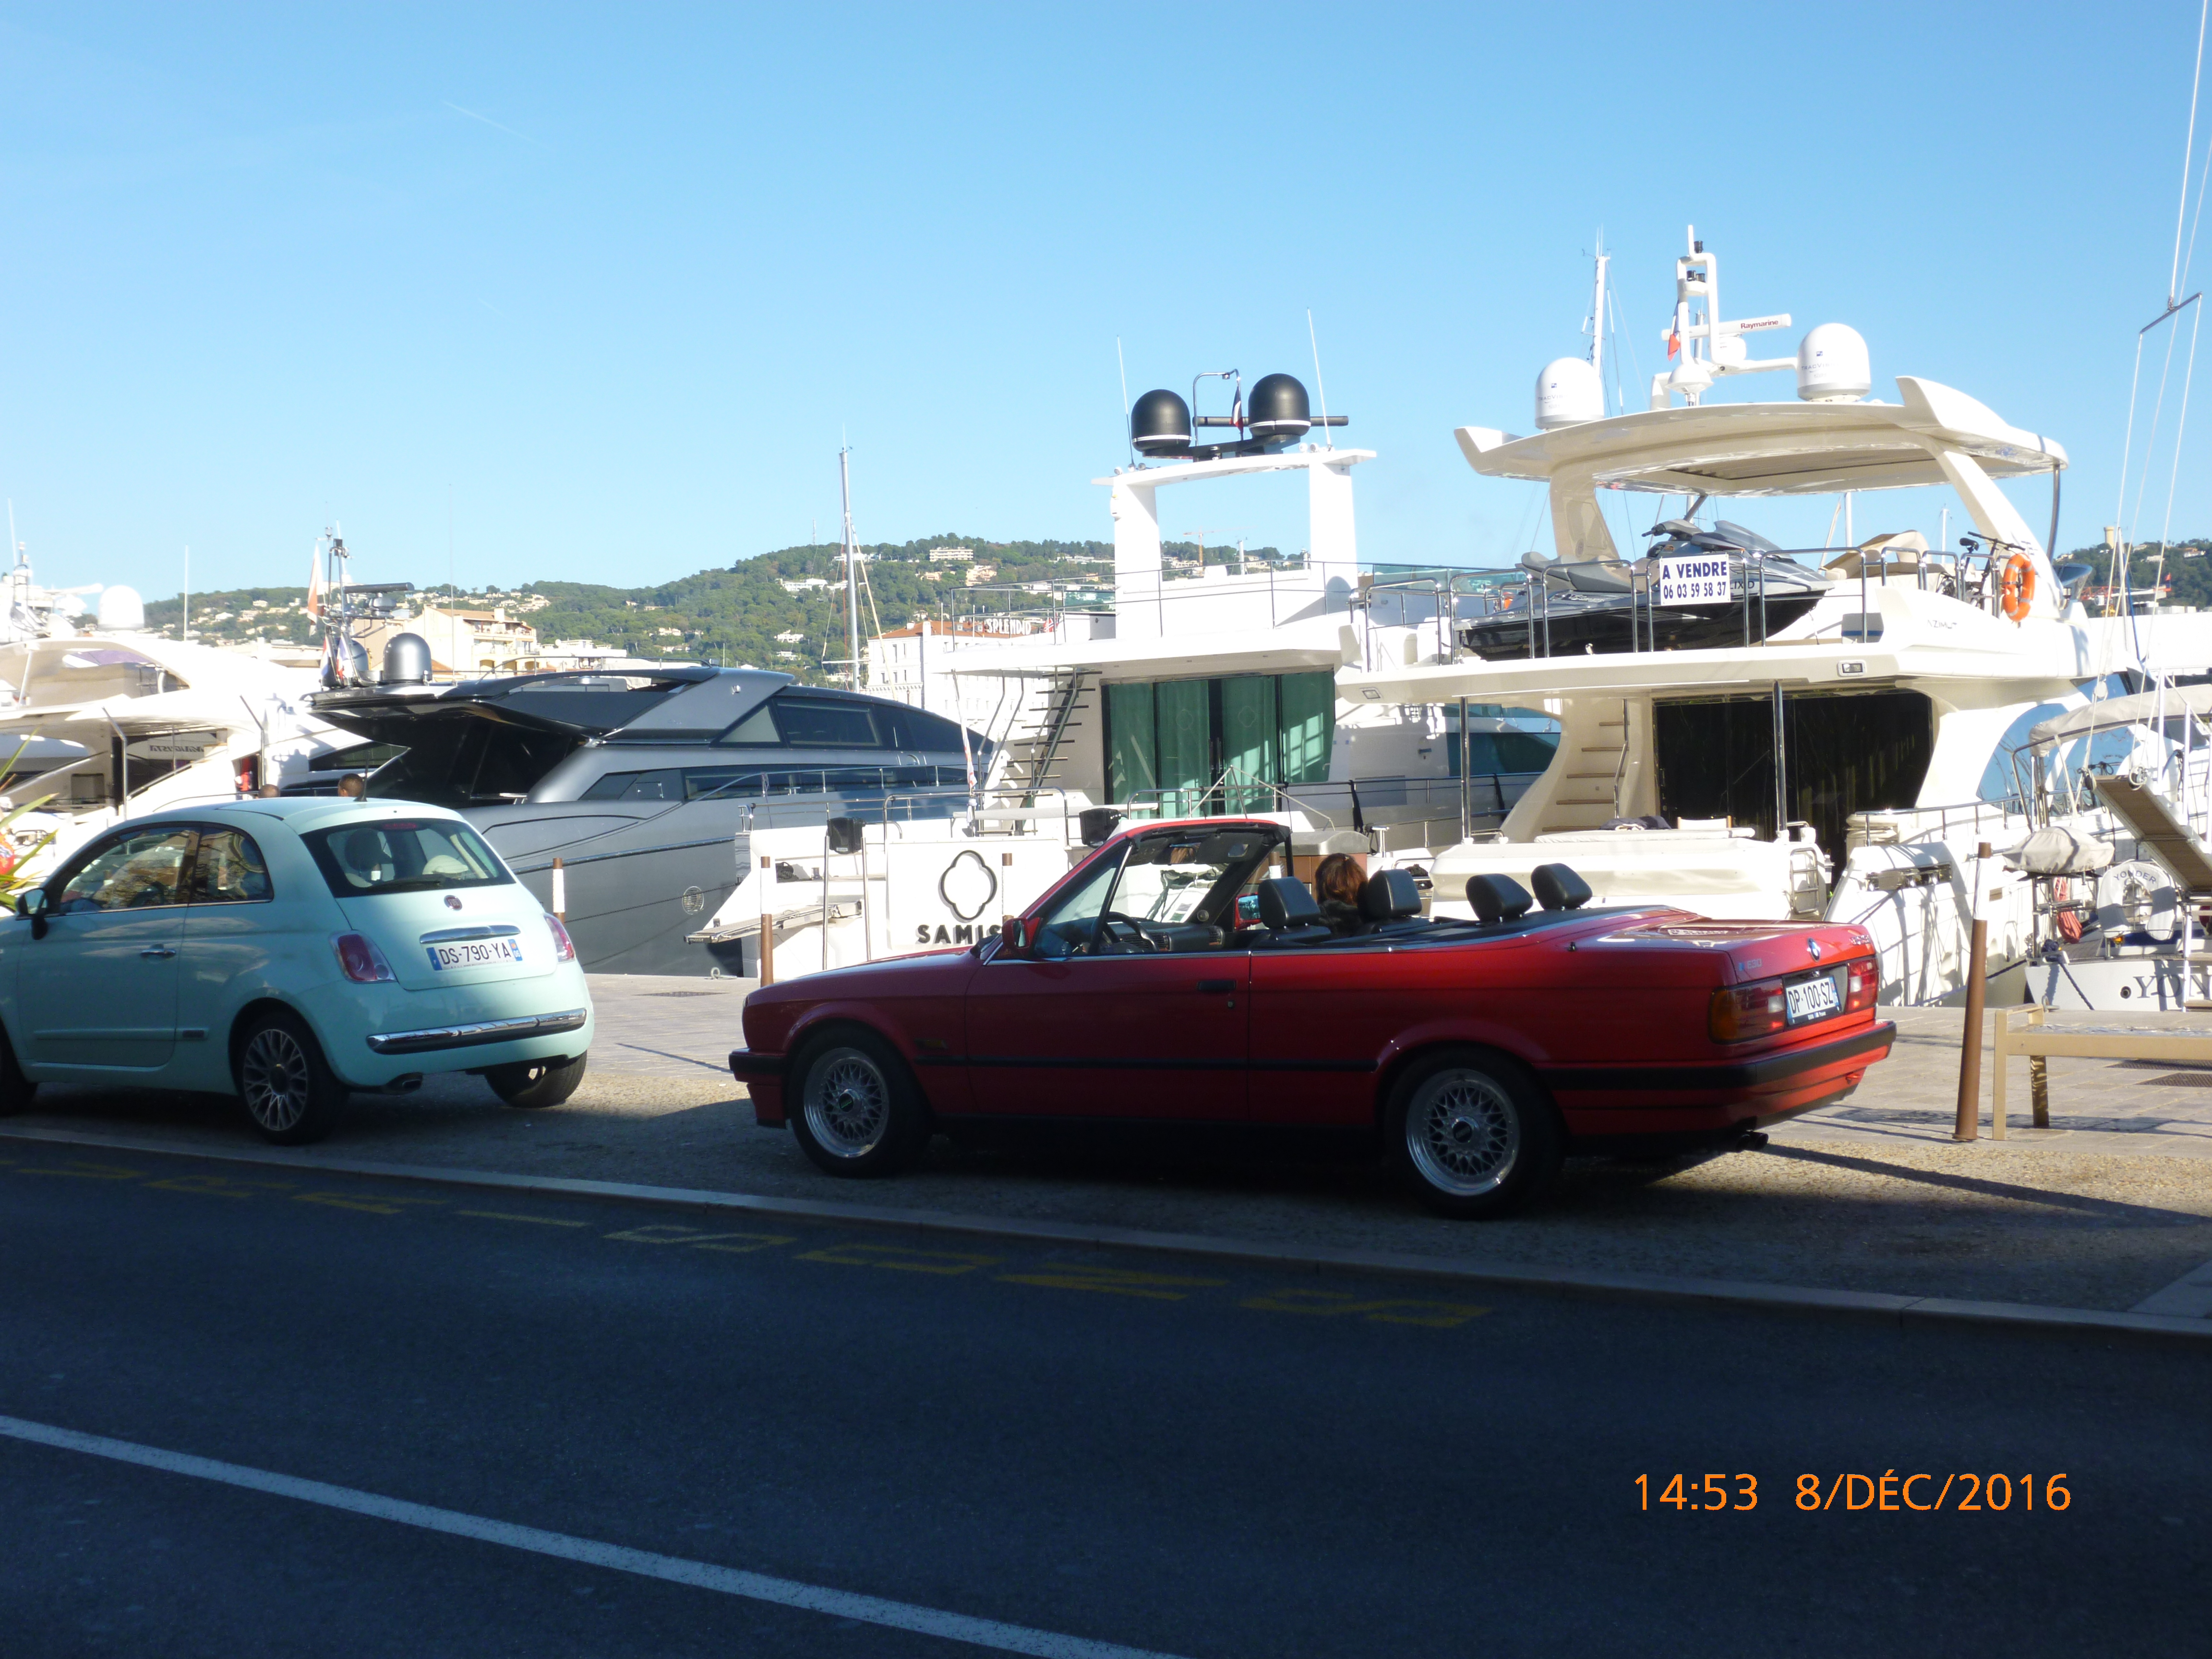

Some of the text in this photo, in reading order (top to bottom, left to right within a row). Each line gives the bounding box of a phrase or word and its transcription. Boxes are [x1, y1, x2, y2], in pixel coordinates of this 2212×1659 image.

[1741, 319, 1779, 329] Raymarine
[1662, 561, 1727, 579] A VENDRE
[1663, 581, 1727, 599] 06 03 59 58 37
[986, 618, 1032, 635] SPLENDID
[438, 942, 512, 965] DS-790-YA
[1788, 981, 1834, 1014] DP-100-SZ
